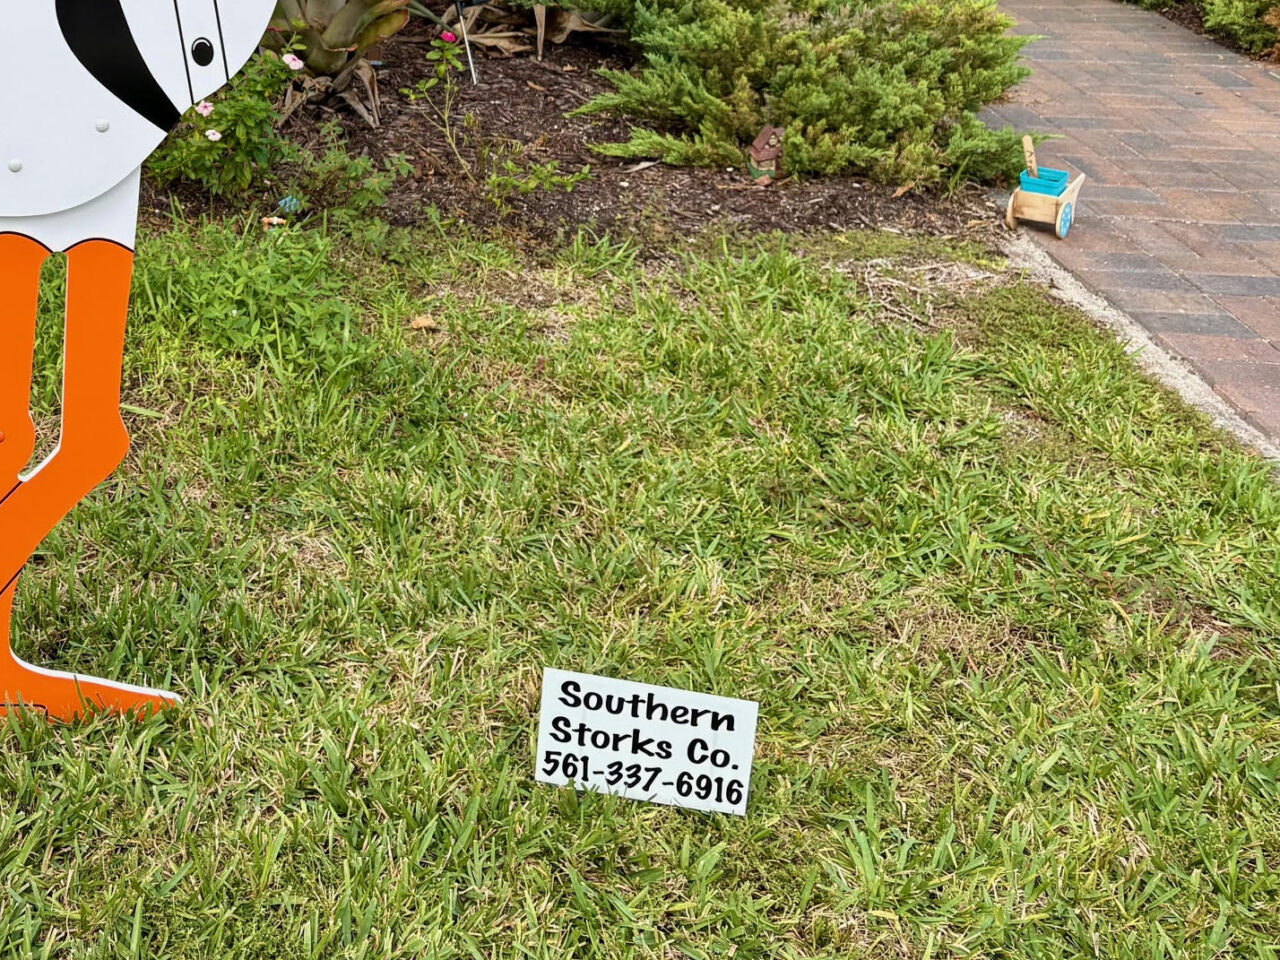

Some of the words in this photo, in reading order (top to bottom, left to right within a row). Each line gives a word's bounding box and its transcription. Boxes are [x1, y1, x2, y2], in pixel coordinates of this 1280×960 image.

[558, 680, 735, 732] Southern
[549, 716, 672, 759] Storks
[687, 738, 739, 770] Co.
[542, 750, 744, 805] 561-337-6916
